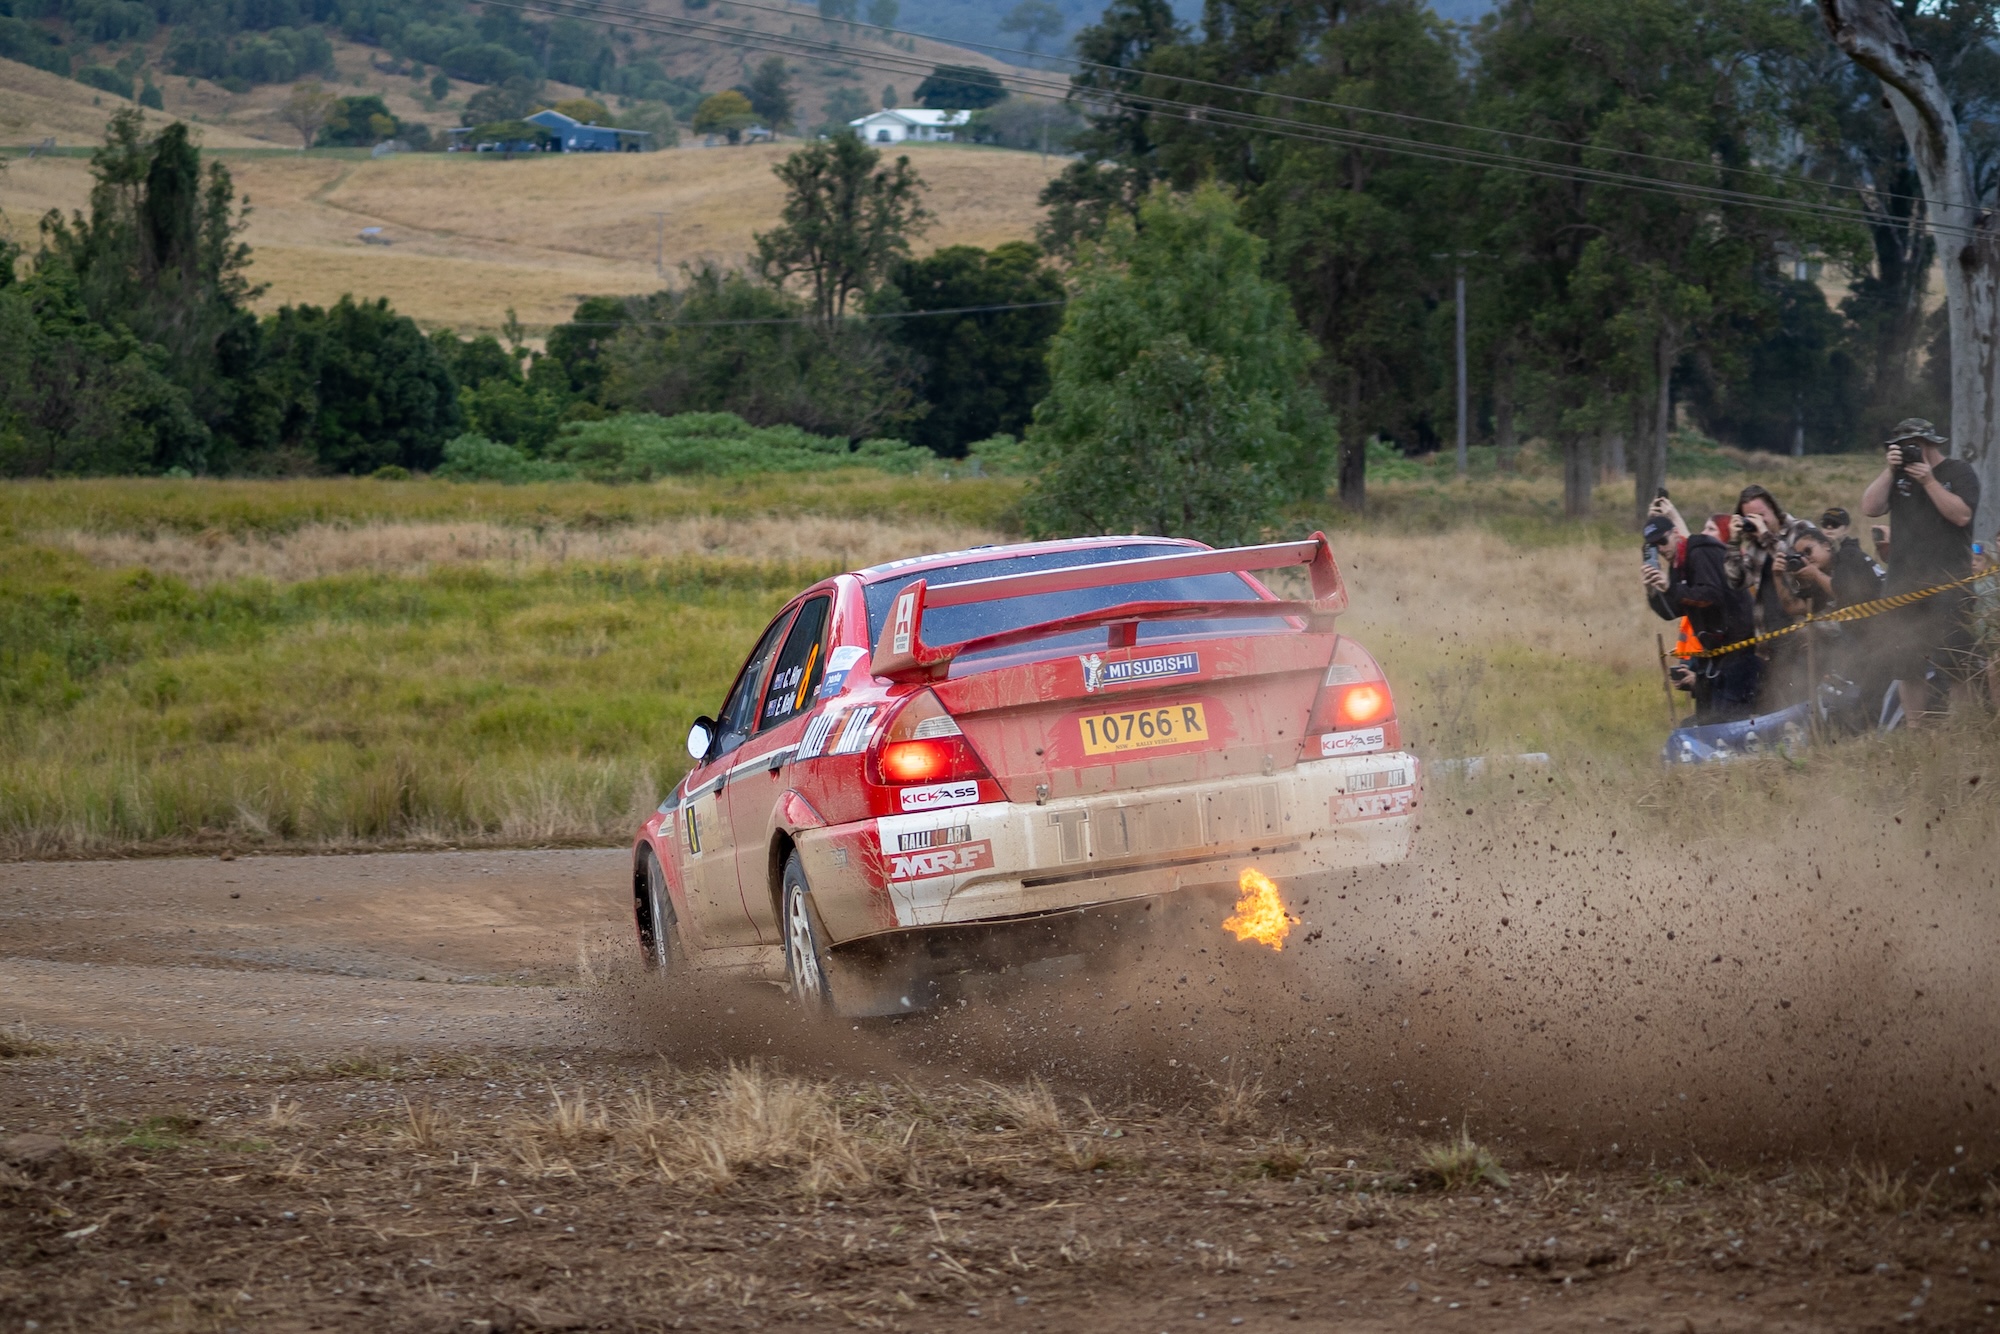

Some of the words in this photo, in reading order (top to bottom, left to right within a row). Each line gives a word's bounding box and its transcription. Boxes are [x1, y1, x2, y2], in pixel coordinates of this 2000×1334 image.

[795, 643, 819, 710] 8
[1109, 655, 1193, 678] MITSUBISHI
[1085, 709, 1173, 746] 10766
[1181, 706, 1203, 733] R
[902, 787, 977, 805] KICKASS
[1335, 790, 1413, 819] MRF
[901, 831, 932, 851] RALLI
[947, 826, 967, 844] ART
[891, 844, 986, 879] MRF
